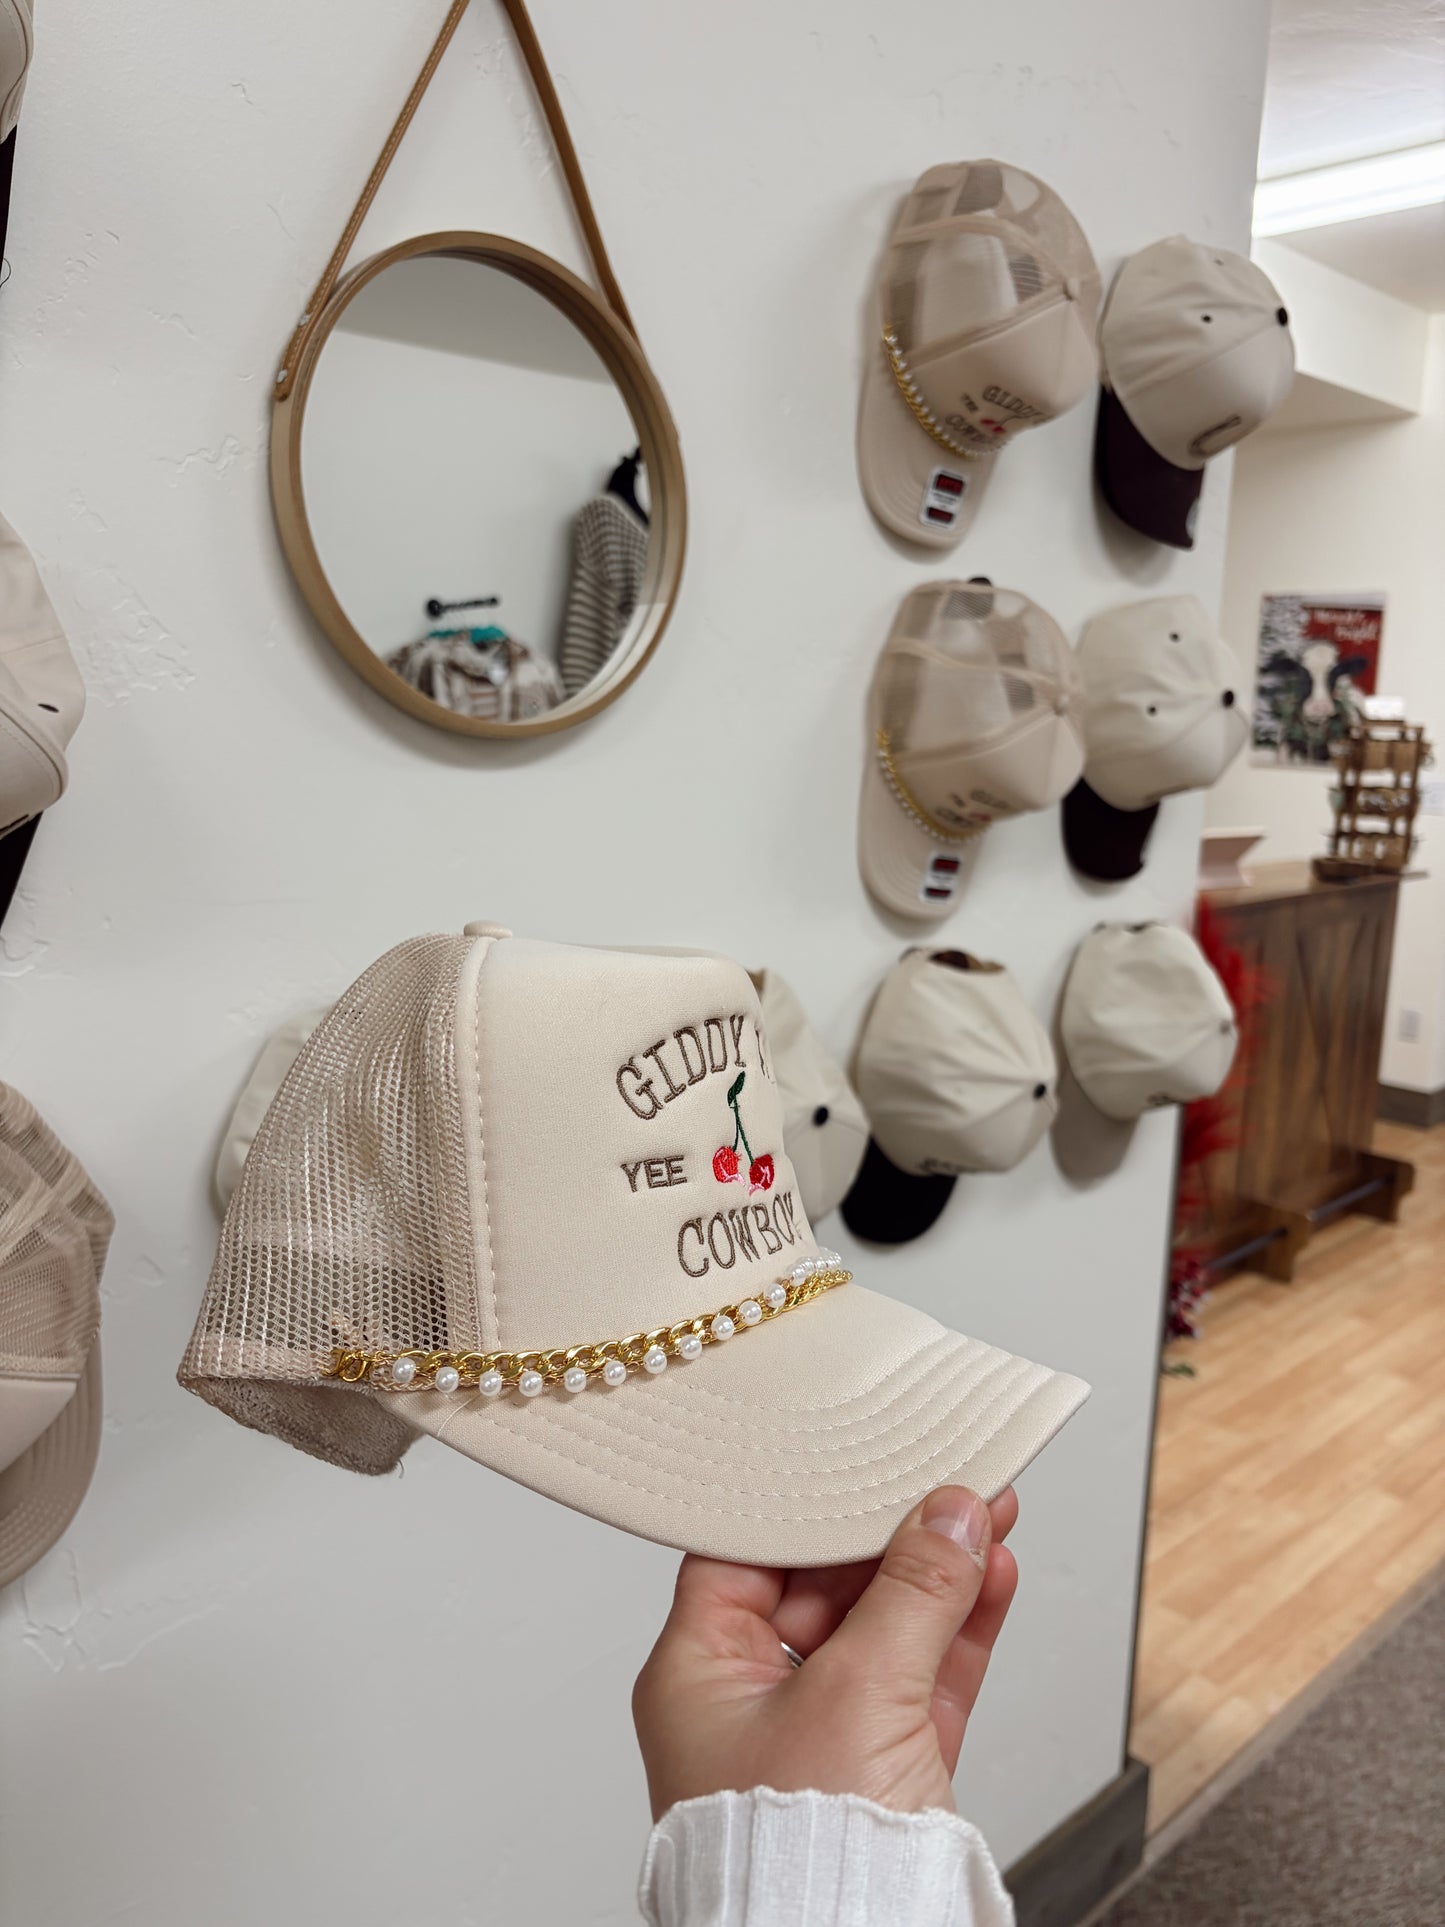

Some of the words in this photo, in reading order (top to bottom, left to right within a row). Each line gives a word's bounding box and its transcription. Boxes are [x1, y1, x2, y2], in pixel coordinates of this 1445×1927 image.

[616, 1015, 746, 1120] GIDDY
[621, 1155, 687, 1192] YEE
[677, 1191, 802, 1277] COWBOY
